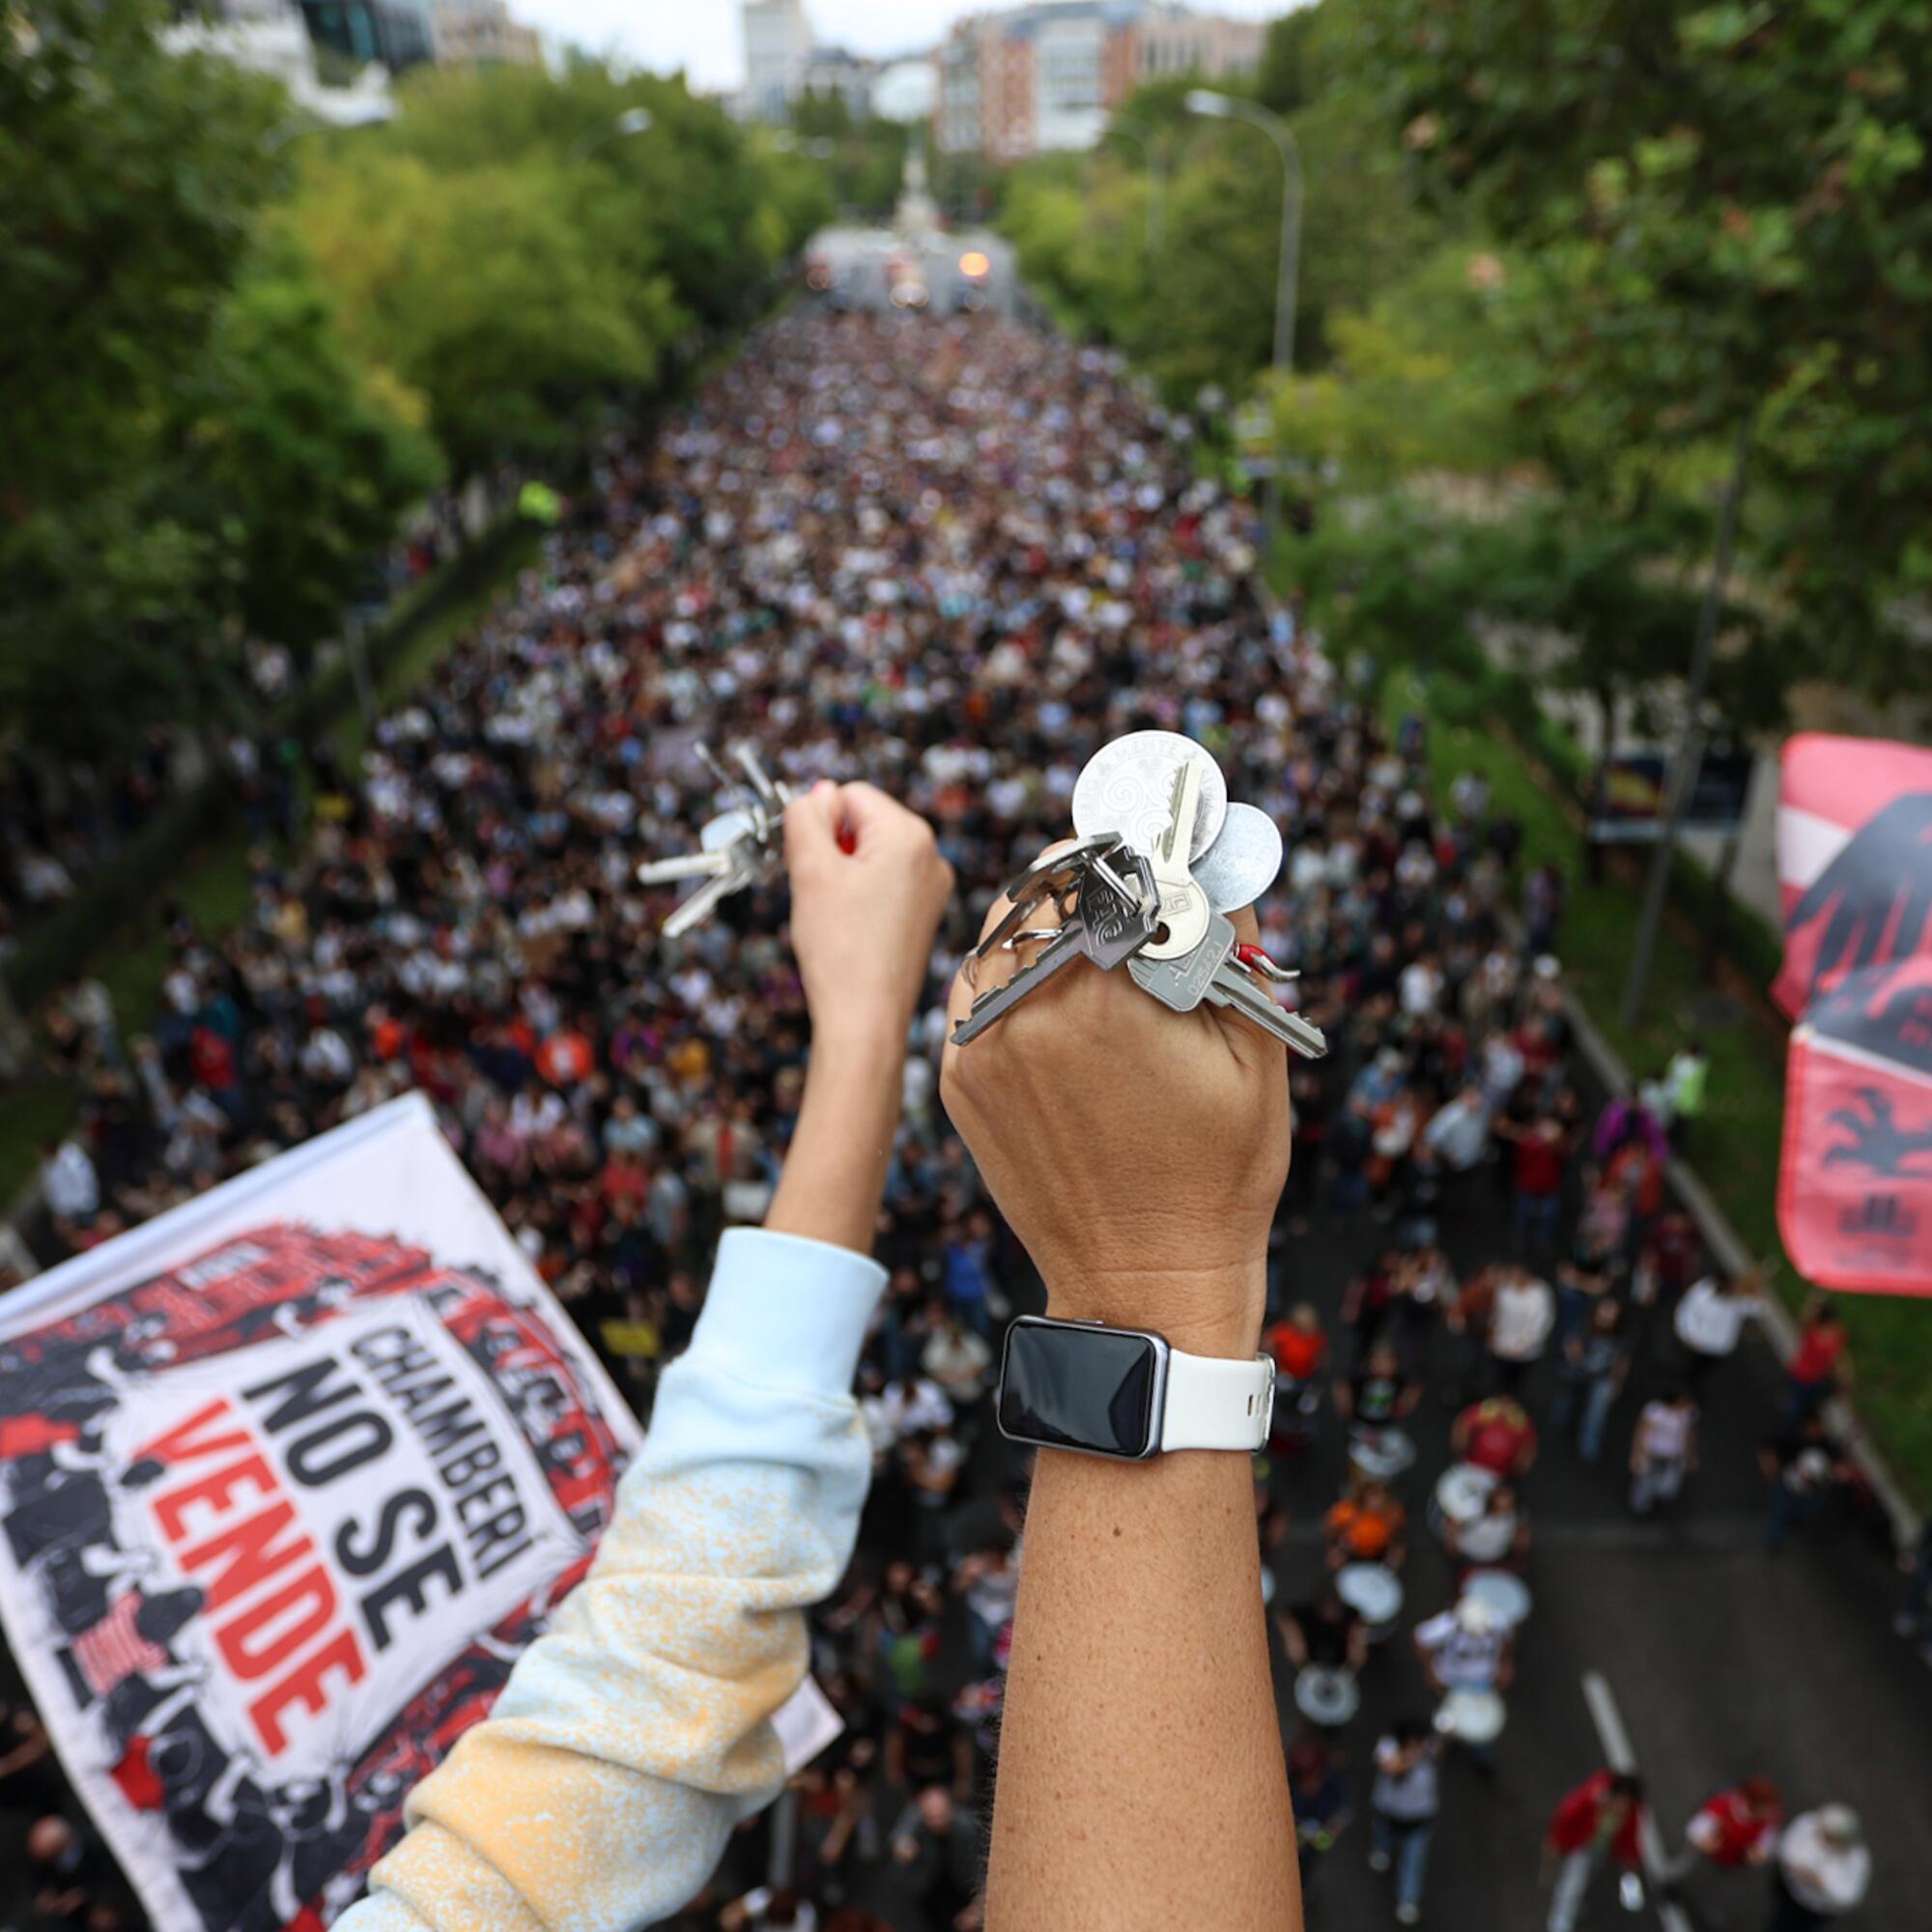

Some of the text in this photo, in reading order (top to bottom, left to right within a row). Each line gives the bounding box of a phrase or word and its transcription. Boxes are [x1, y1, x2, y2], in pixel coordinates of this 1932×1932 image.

[132, 1398, 366, 1757] VENDE
[242, 1357, 463, 1653] NO SE
